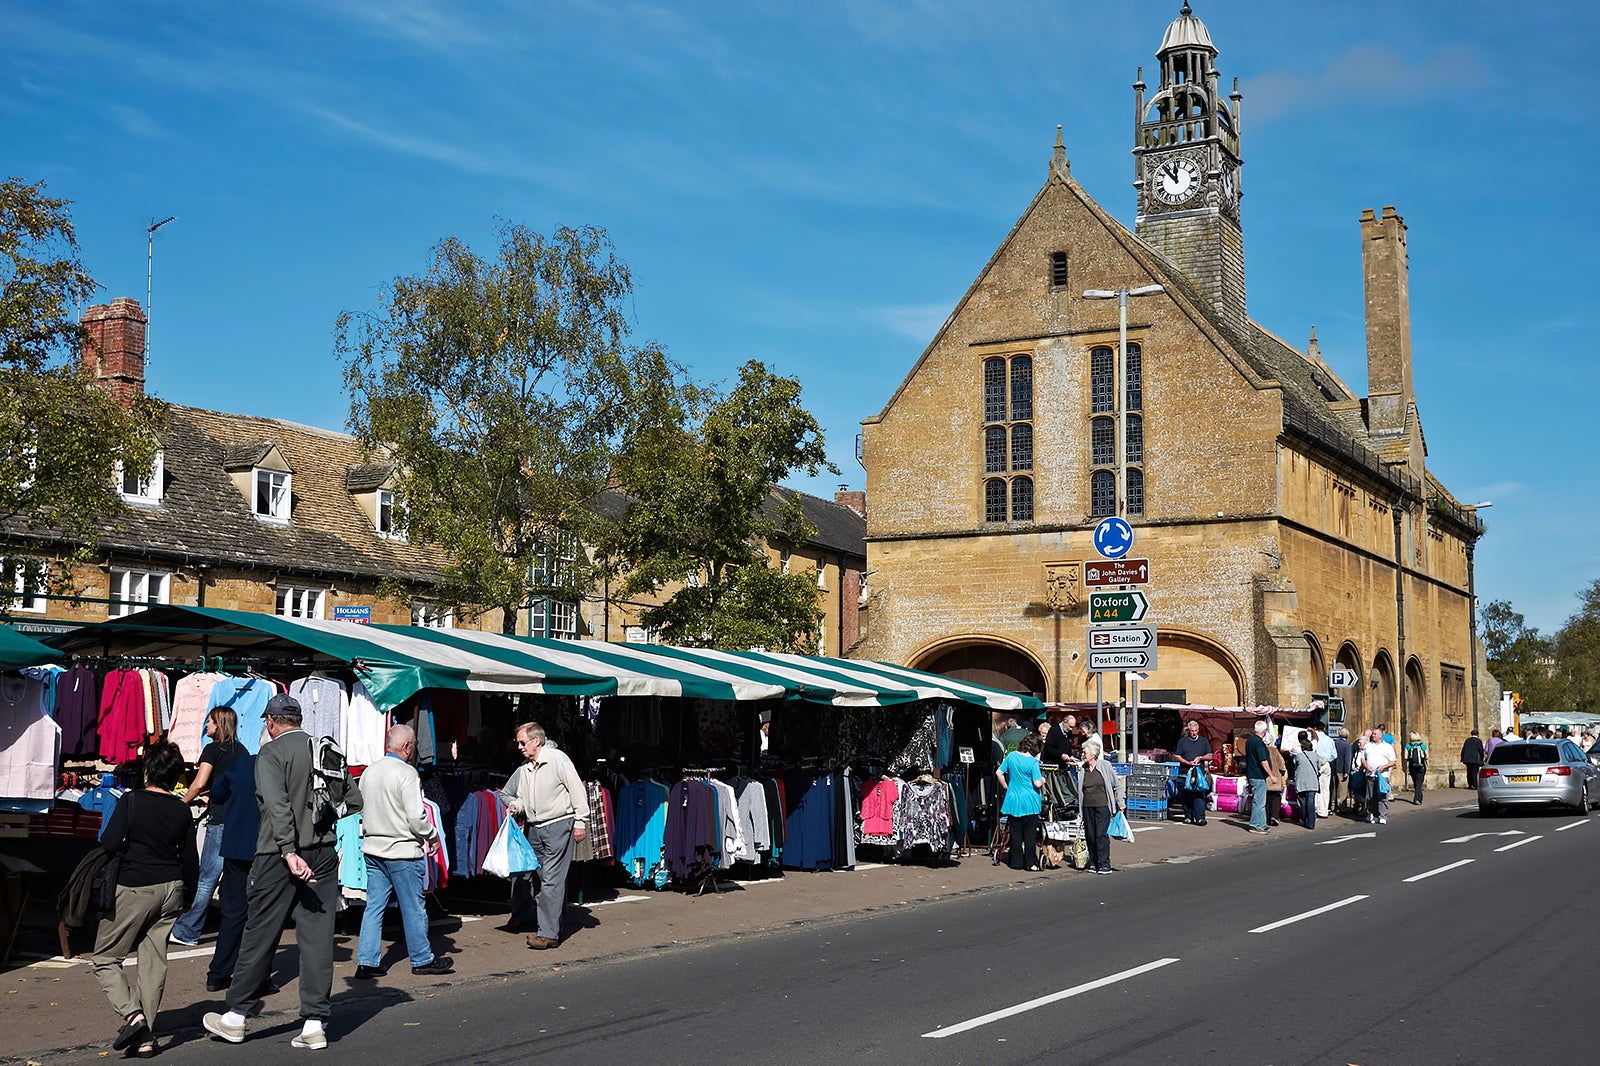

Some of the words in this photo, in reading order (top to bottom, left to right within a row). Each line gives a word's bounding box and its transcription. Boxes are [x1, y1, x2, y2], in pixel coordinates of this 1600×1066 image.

[1093, 597, 1129, 607] Oxford
[1094, 609, 1101, 618] A
[1103, 609, 1118, 618] 44
[18, 624, 53, 633] LONDON
[1112, 635, 1141, 643] Station
[1094, 656, 1112, 664] Post
[1334, 673, 1343, 684] P
